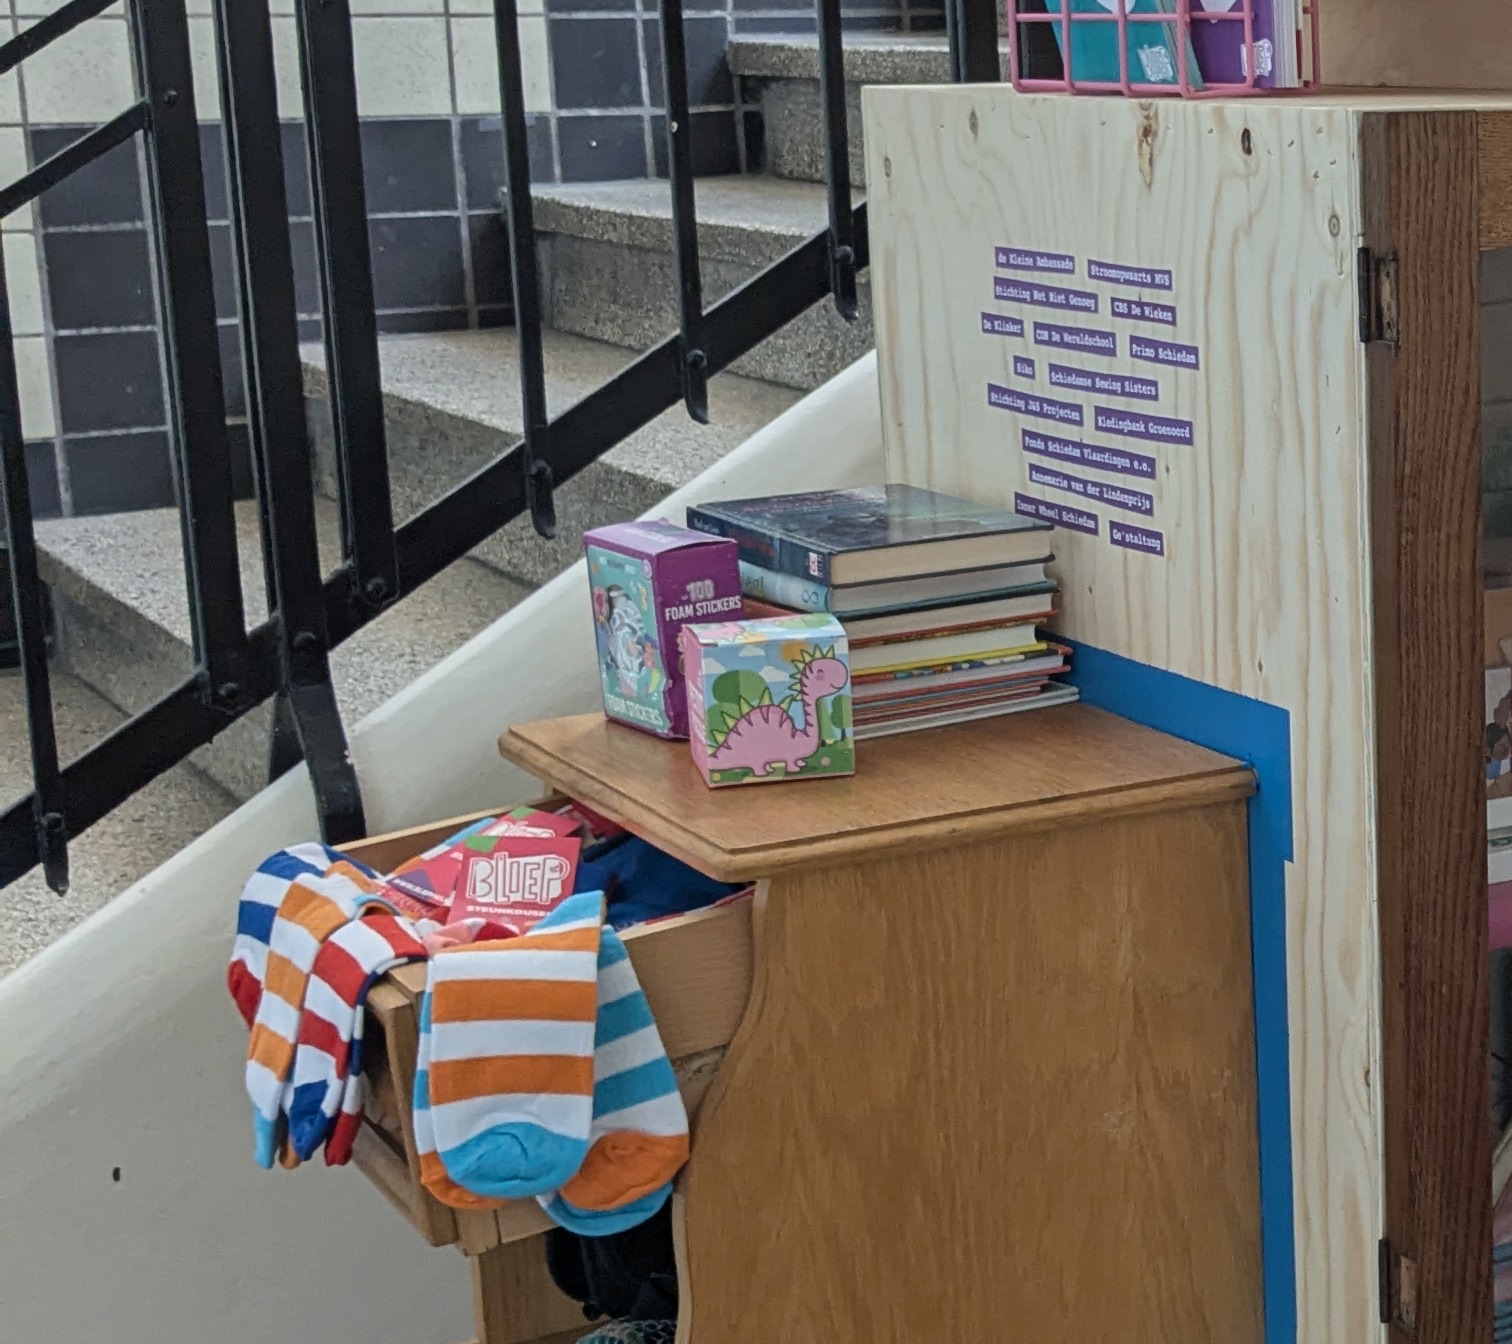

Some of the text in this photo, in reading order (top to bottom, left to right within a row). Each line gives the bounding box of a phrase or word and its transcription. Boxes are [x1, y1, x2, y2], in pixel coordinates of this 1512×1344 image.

[1009, 254, 1034, 266] Kleine
[1036, 256, 1074, 270] Ambassade
[1091, 264, 1152, 283] Stroomopwaarts
[995, 285, 1031, 302] Stichting
[1048, 291, 1066, 304] Niet
[1068, 294, 1095, 311] Genoeg
[1131, 304, 1141, 316] De
[1144, 306, 1173, 321] Wieken
[994, 319, 1022, 334] Klinker
[1051, 331, 1061, 342] De
[1063, 332, 1114, 348] Wereldschool
[1132, 344, 1196, 364] Primo Schiedam
[1051, 371, 1156, 396] Schiedamse Sewing Sisters
[990, 391, 1026, 411] Stichting
[1043, 403, 1080, 421] Projecten
[1097, 415, 1190, 439] Kledingbank Groenoord
[1025, 436, 1151, 473] Fonds Schiedam Vlaardingen e.o.
[1031, 469, 1068, 489] Annemarie
[1071, 481, 1083, 493] van
[1087, 482, 1100, 497] der
[1062, 510, 1096, 529] Schiedam
[665, 595, 742, 622] FOAM STICKERS
